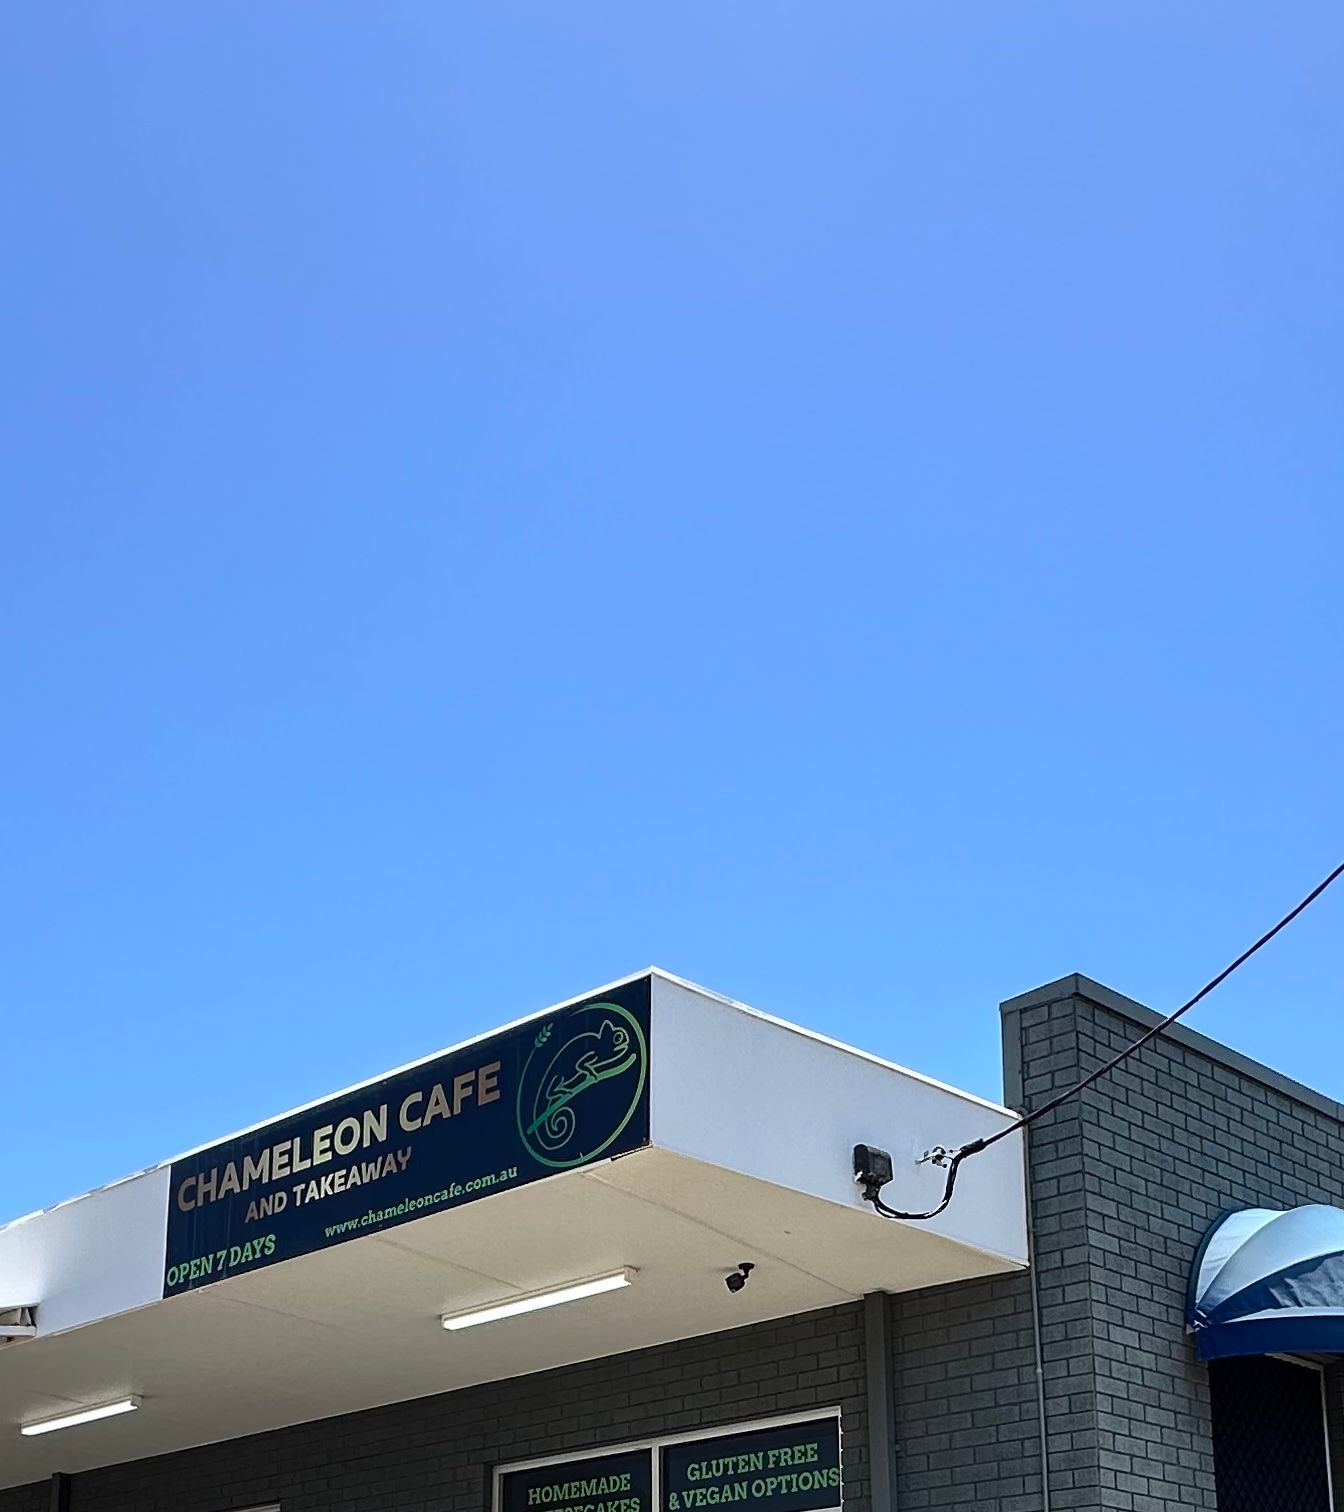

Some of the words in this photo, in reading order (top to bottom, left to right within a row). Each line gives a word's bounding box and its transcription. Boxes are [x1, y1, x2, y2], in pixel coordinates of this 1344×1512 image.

[176, 1104, 388, 1213] CHAMELEON
[399, 1060, 501, 1133] CAFE
[244, 1190, 288, 1224] AND
[292, 1146, 413, 1207] TAKEAWAY
[324, 1166, 518, 1239] www.chameleoncafe.com.au
[166, 1252, 213, 1287] OPEN
[216, 1248, 228, 1272] 7
[229, 1234, 277, 1268] DAYS
[668, 1491, 681, 1511] &
[682, 1481, 749, 1508] VEGAN
[751, 1467, 840, 1498] OPTIONS
[686, 1451, 764, 1482] GLUTEN
[767, 1443, 819, 1469] FREE
[528, 1473, 632, 1506] HOMEMADE
